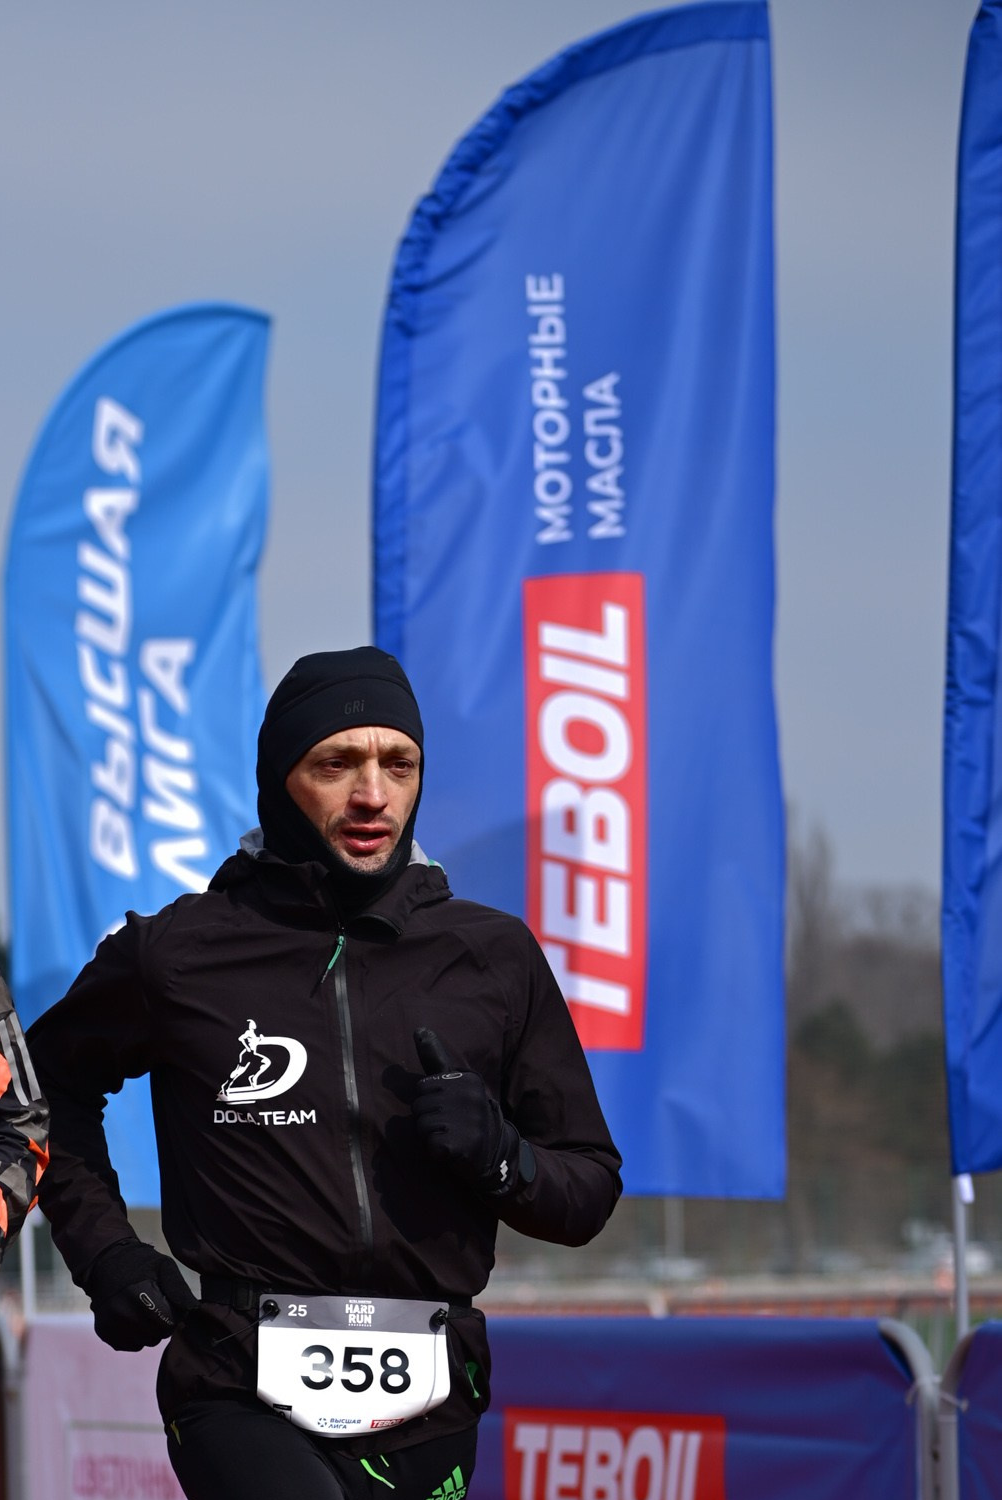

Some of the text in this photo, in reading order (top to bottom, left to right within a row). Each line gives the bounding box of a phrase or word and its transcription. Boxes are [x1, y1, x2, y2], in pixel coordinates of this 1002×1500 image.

[525, 272, 574, 545] МОТОРНЫЕ
[582, 370, 627, 540] МАСЛА
[74, 395, 145, 879] ВЫСШАЯ
[138, 637, 211, 893] ЛИГА
[538, 600, 633, 1017] TEBOIL
[287, 1304, 308, 1317] 25
[345, 1303, 375, 1315] HARD
[348, 1313, 372, 1324] RUN
[300, 1344, 411, 1394] 358
[329, 1417, 362, 1425] ВЫСШАЯ
